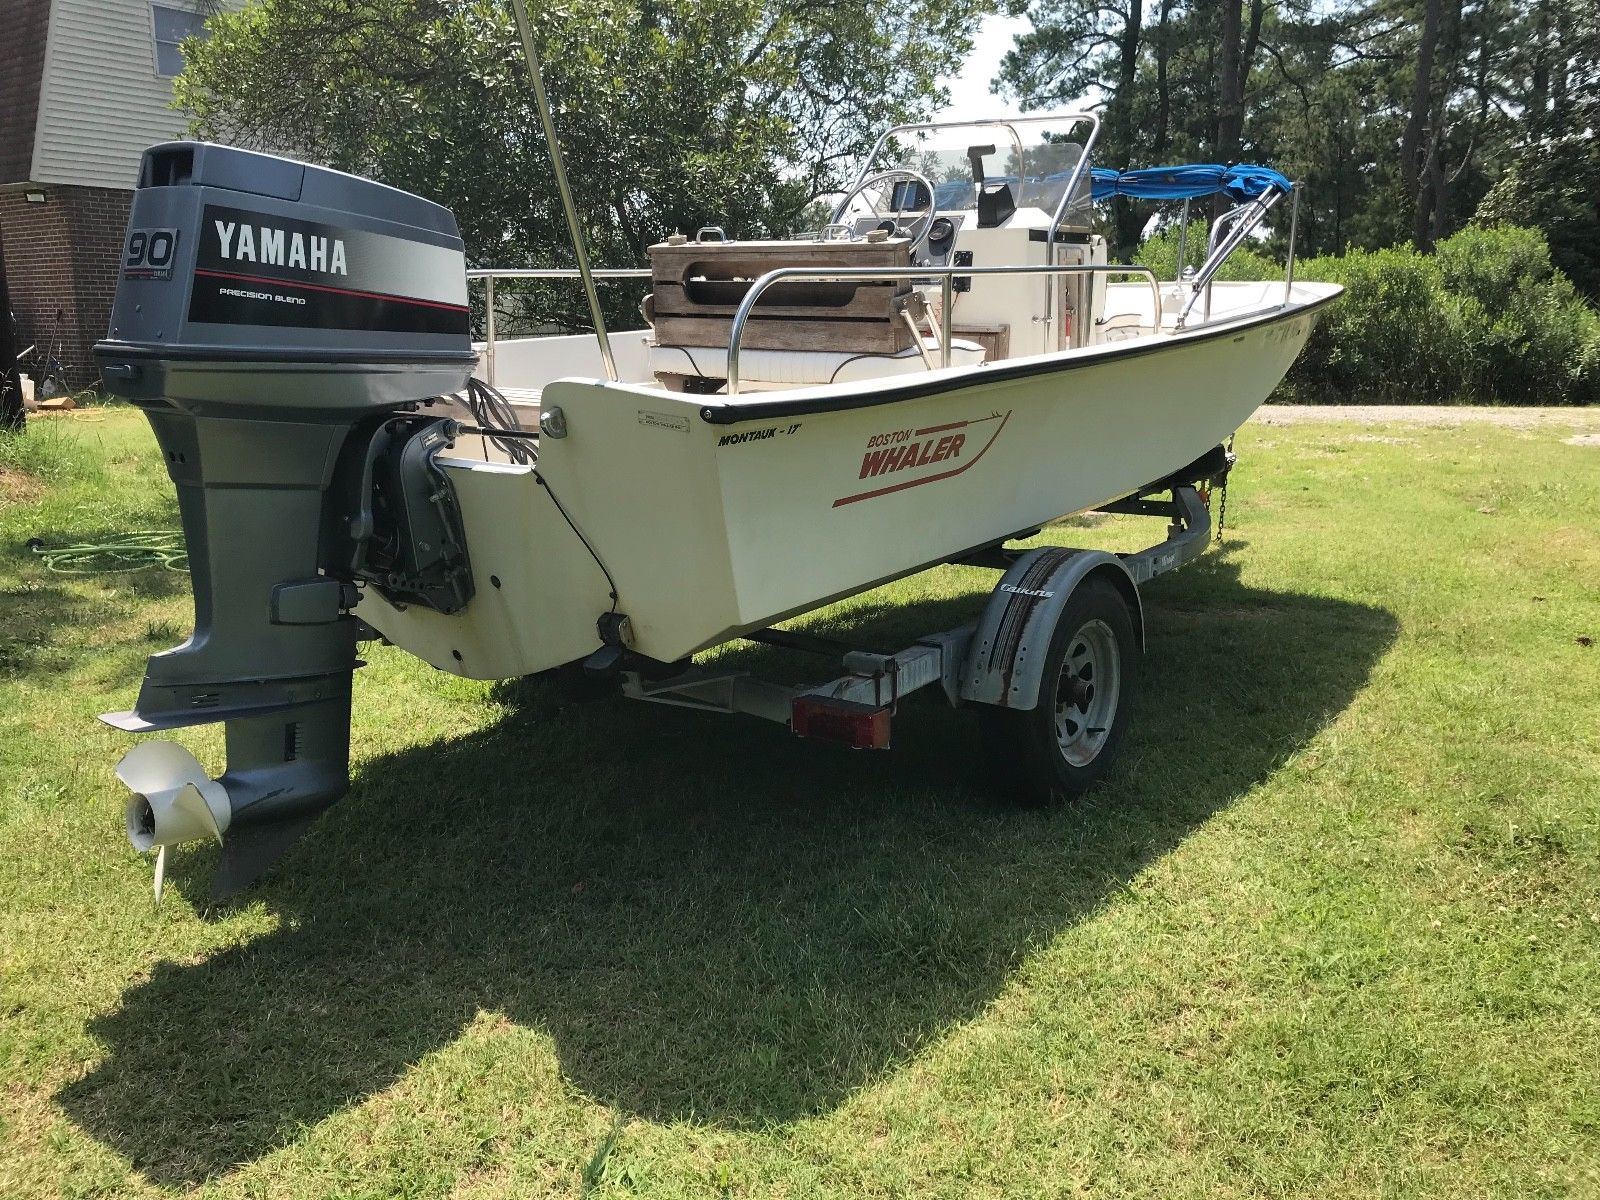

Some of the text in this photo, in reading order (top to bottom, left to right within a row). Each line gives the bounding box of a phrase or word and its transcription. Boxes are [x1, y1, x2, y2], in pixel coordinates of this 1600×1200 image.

[127, 231, 174, 266] 90
[214, 220, 348, 276] YAMAHA
[219, 287, 306, 305] PRECISION BLEND
[718, 427, 776, 447] MONTAUK
[866, 428, 913, 449] BOSTON
[858, 434, 966, 480] WHALER
